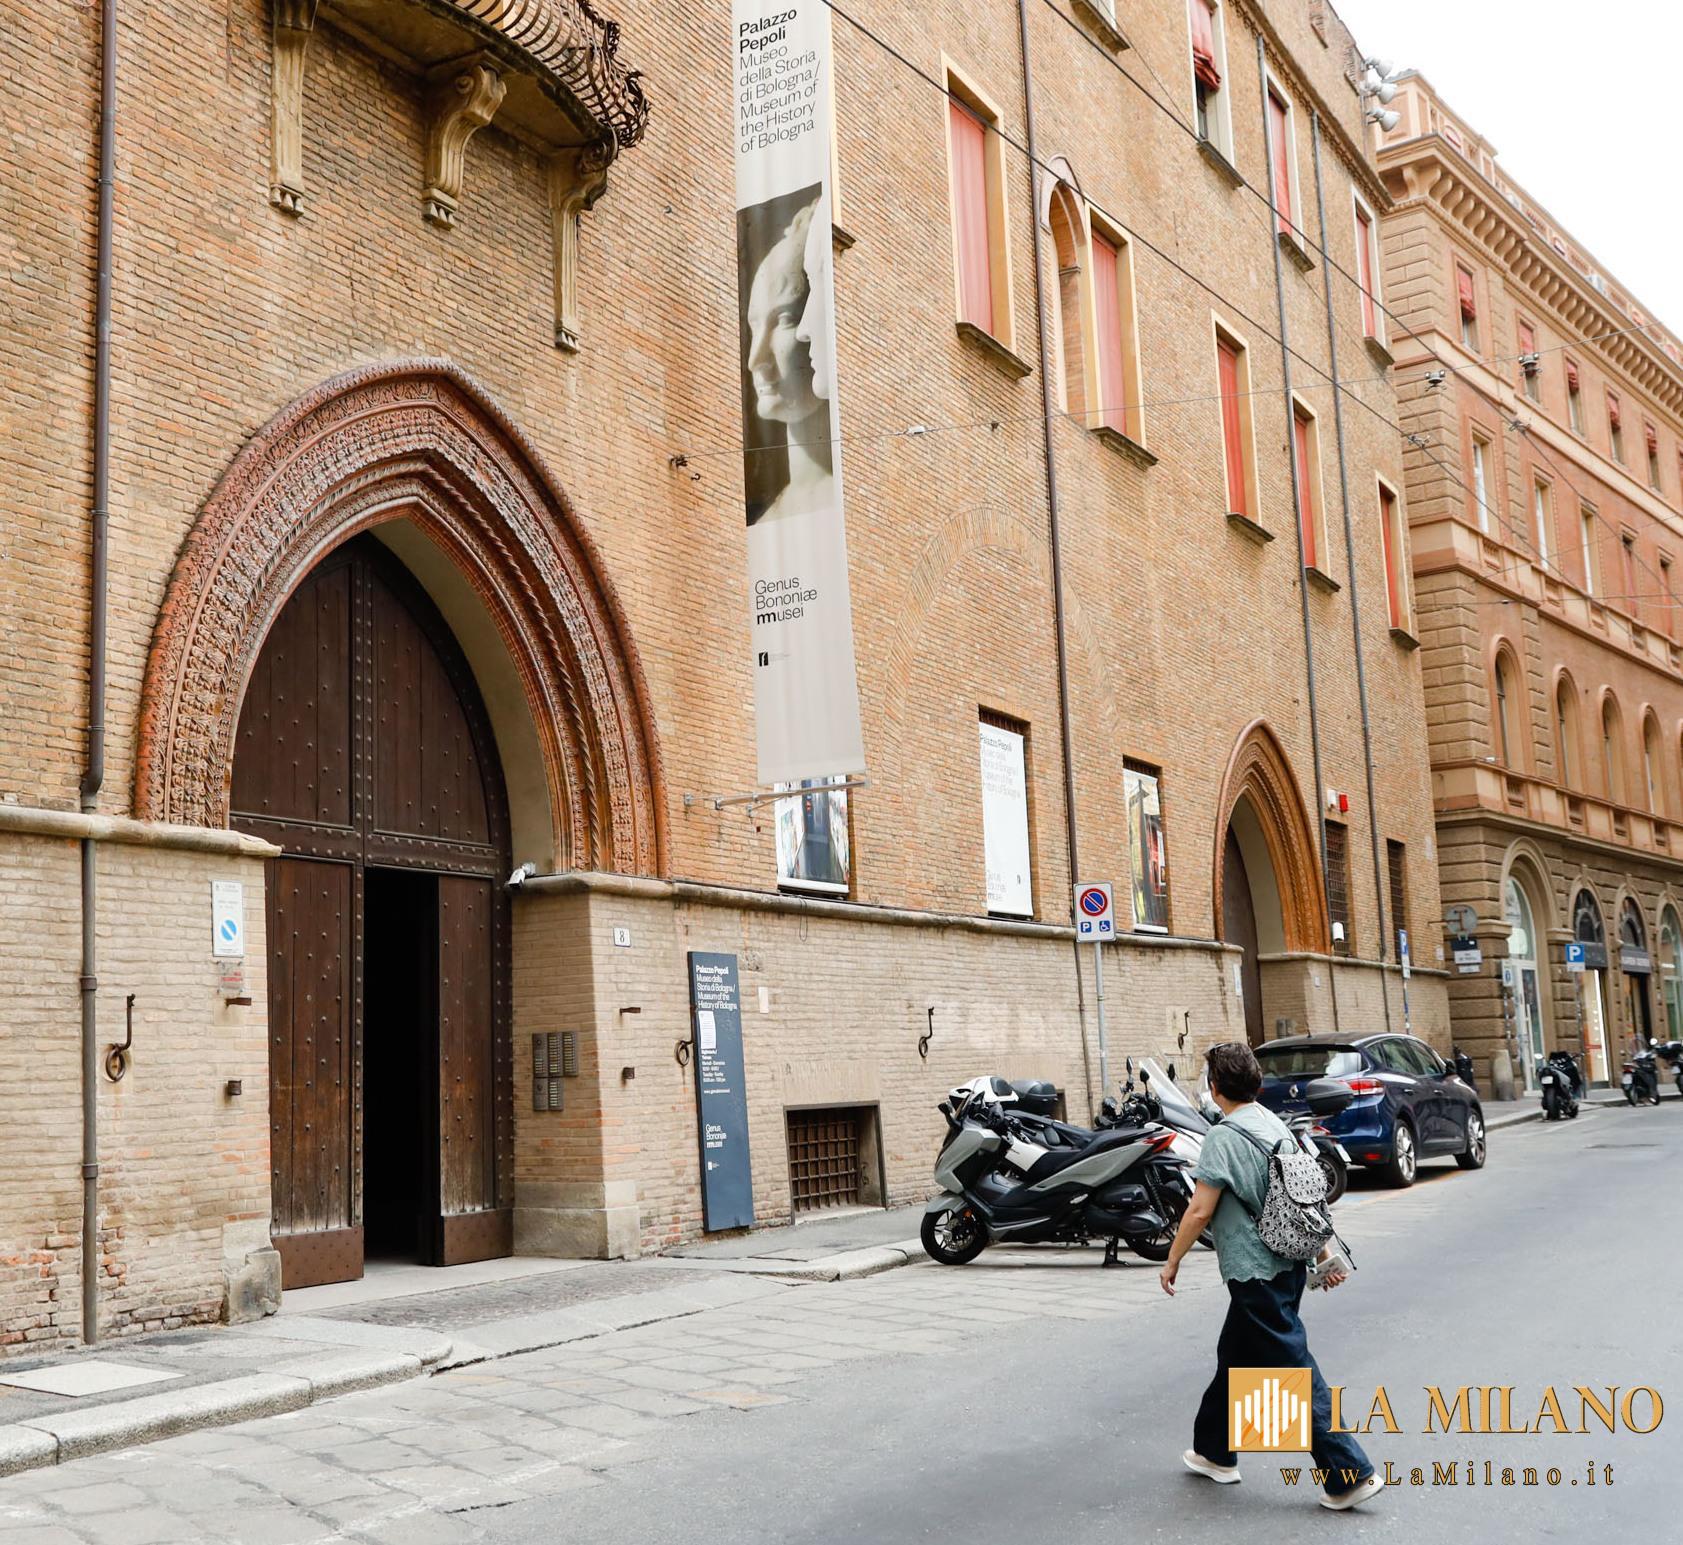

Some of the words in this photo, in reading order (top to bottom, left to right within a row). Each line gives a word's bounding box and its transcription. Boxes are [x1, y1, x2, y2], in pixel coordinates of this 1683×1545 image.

[740, 9, 797, 37] Palazzo
[740, 26, 786, 53] Pepoli
[740, 45, 788, 70] Museo
[740, 69, 772, 87] della
[775, 50, 816, 75] Storia
[740, 89, 752, 103] di
[740, 92, 801, 120] Museum
[804, 79, 819, 97] of
[741, 121, 764, 137] the
[766, 101, 816, 128] History
[741, 136, 756, 153] of
[758, 119, 814, 149] Bologna
[755, 577, 800, 595] Genus
[757, 602, 804, 625] musei
[1569, 945, 1581, 961] P
